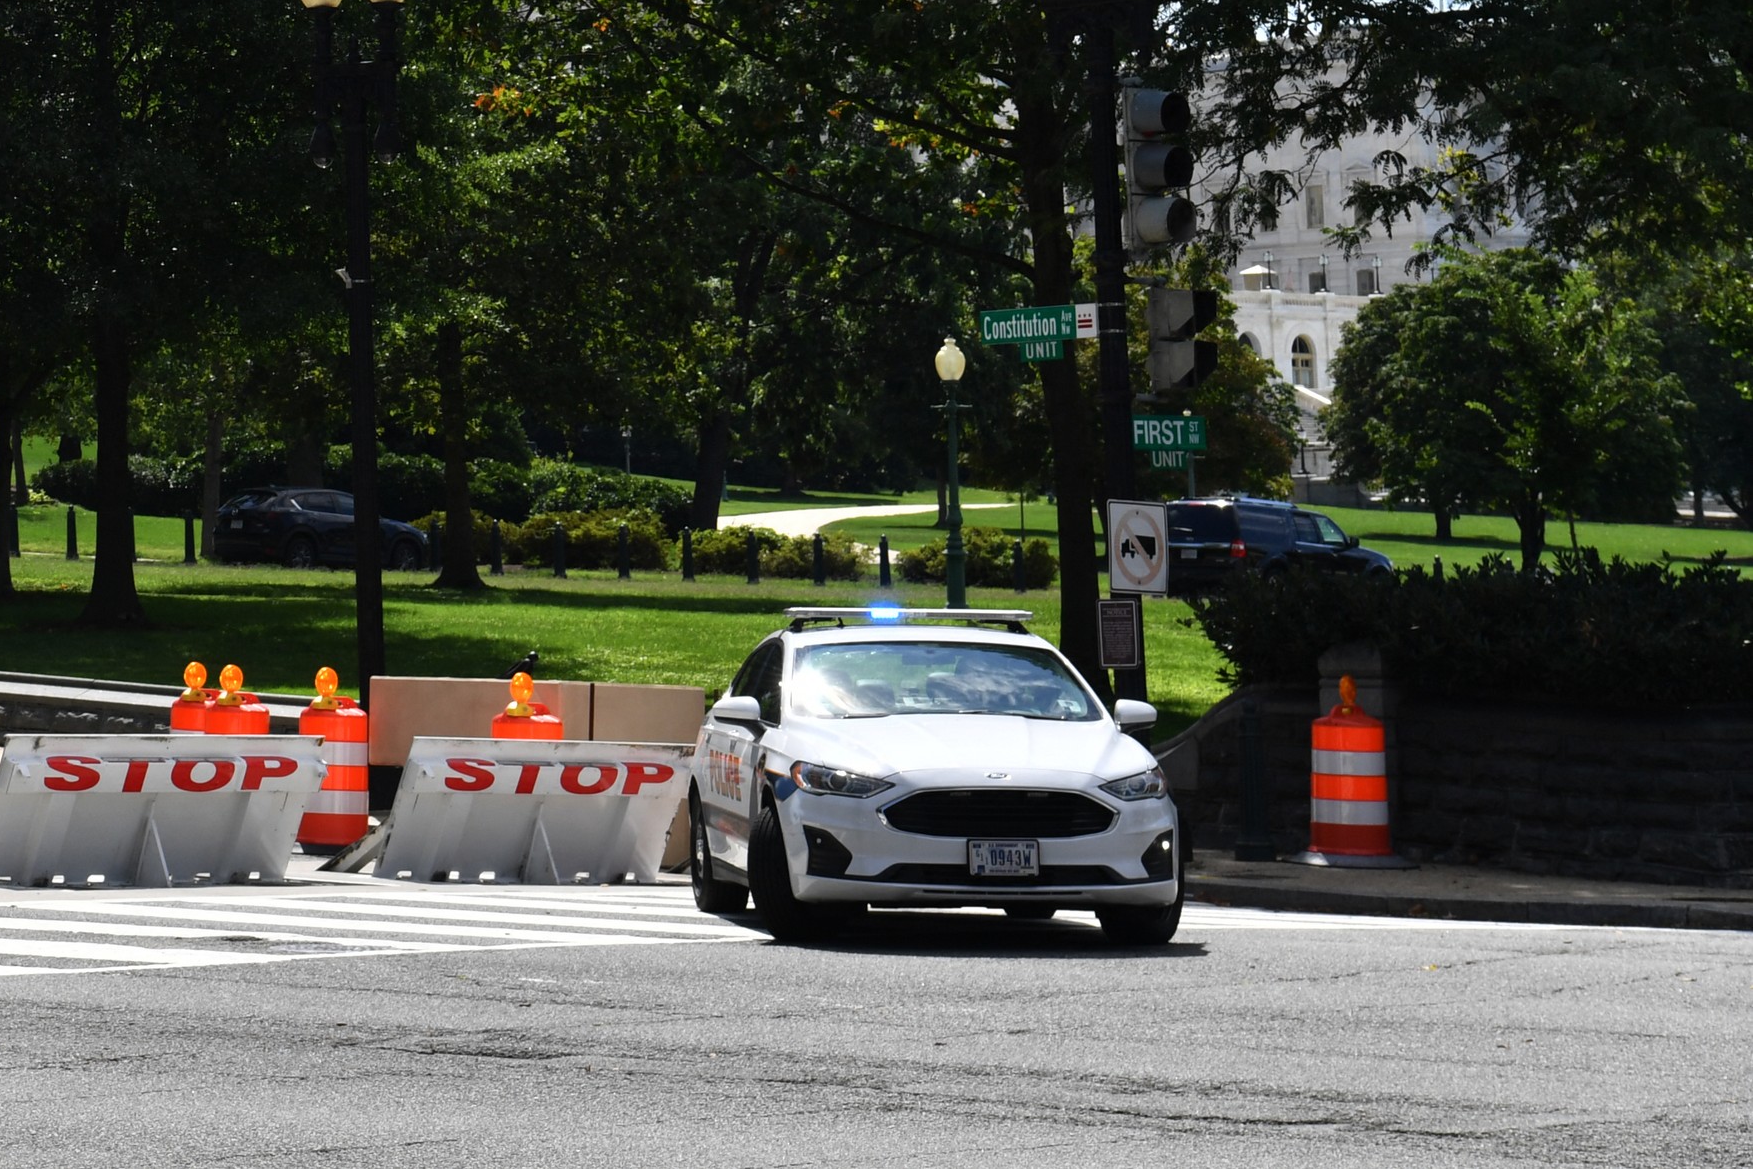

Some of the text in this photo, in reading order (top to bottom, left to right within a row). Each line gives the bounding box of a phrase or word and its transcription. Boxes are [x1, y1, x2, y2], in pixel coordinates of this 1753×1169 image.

[984, 312, 1057, 340] Constitution
[1061, 310, 1072, 322] Ave
[1026, 341, 1057, 359] UNIT
[1133, 420, 1184, 445] FIRST
[1189, 421, 1199, 432] ST
[1189, 434, 1199, 444] NW
[1152, 451, 1184, 467] UNIT
[44, 755, 298, 793] STOP
[445, 758, 675, 795] STOP
[709, 749, 742, 802] POLICE
